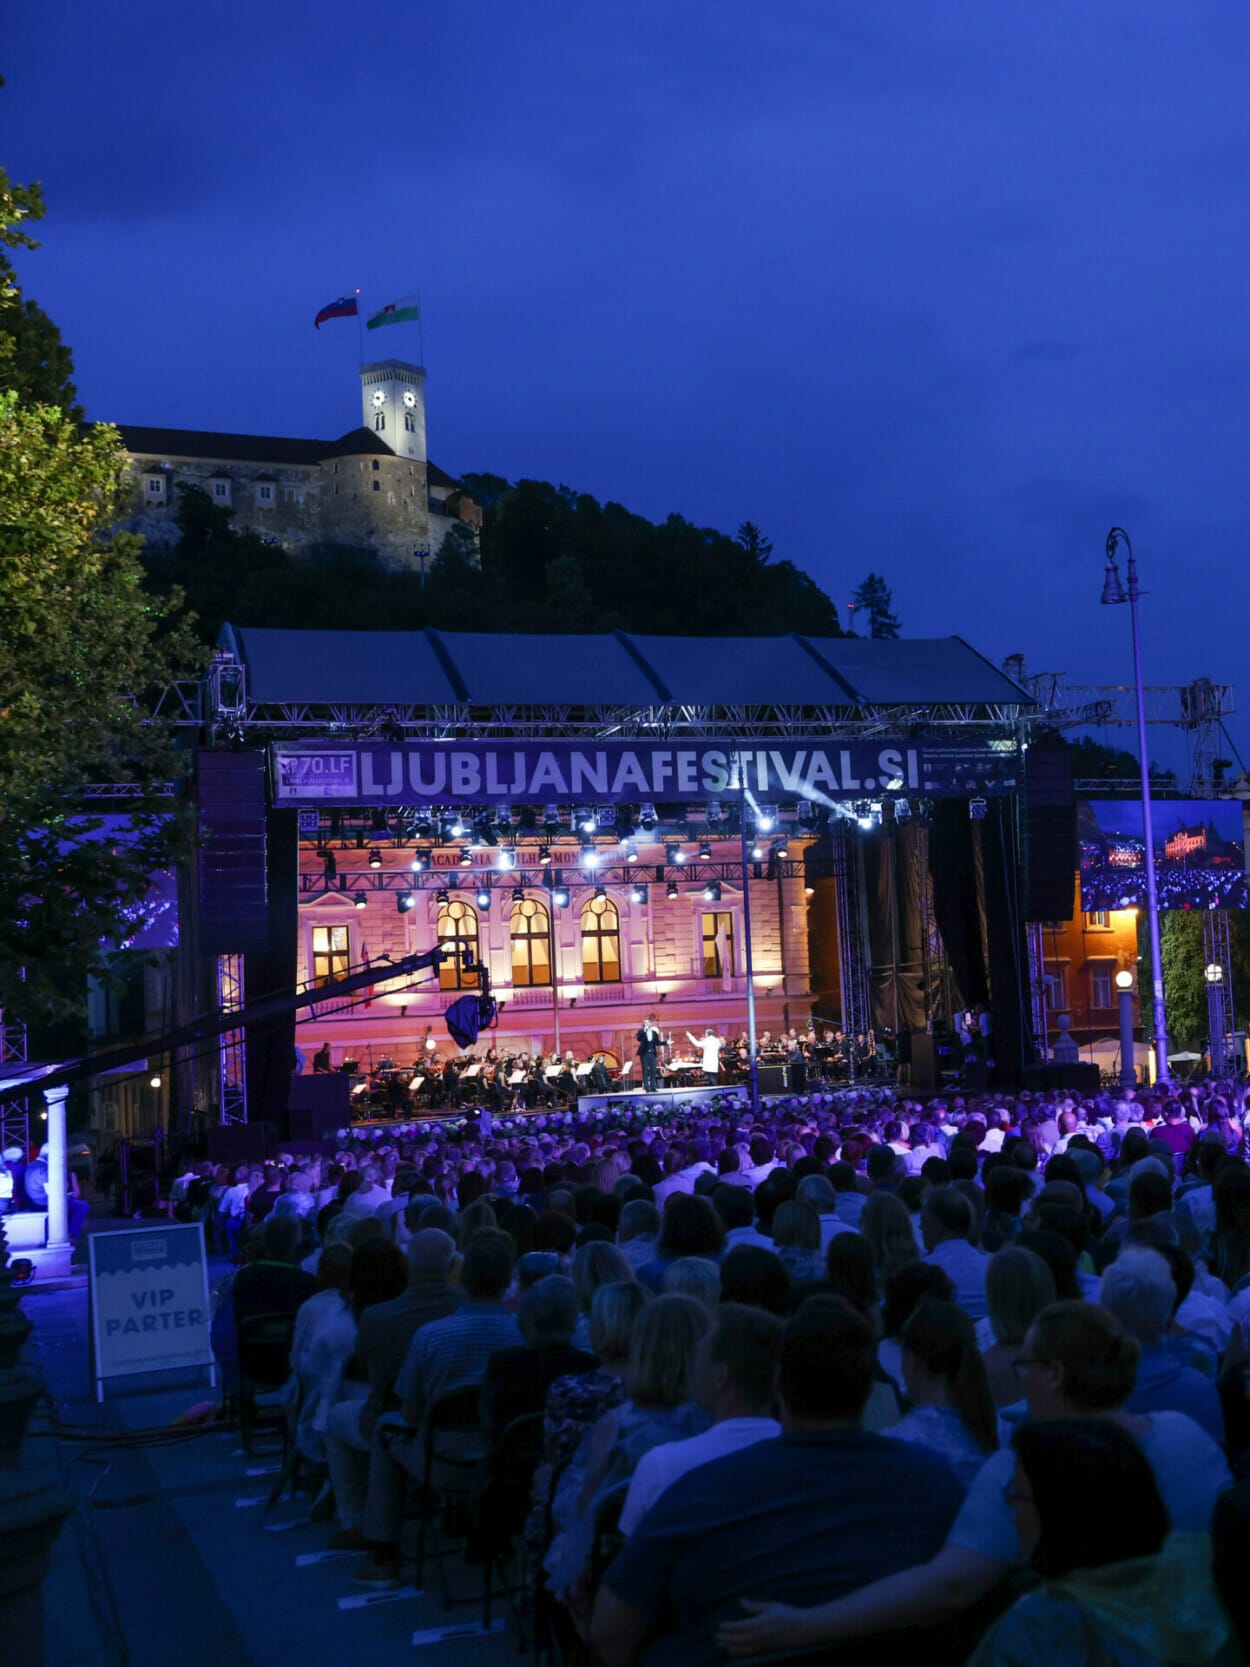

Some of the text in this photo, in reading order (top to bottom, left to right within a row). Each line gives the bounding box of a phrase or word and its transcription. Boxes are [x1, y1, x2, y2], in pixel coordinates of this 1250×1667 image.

[360, 748, 919, 796] LJUBLJANAFESTIVAL.SI
[431, 852, 492, 866] ACADMIA
[131, 1289, 174, 1309] VIP
[106, 1309, 204, 1337] PARTER
